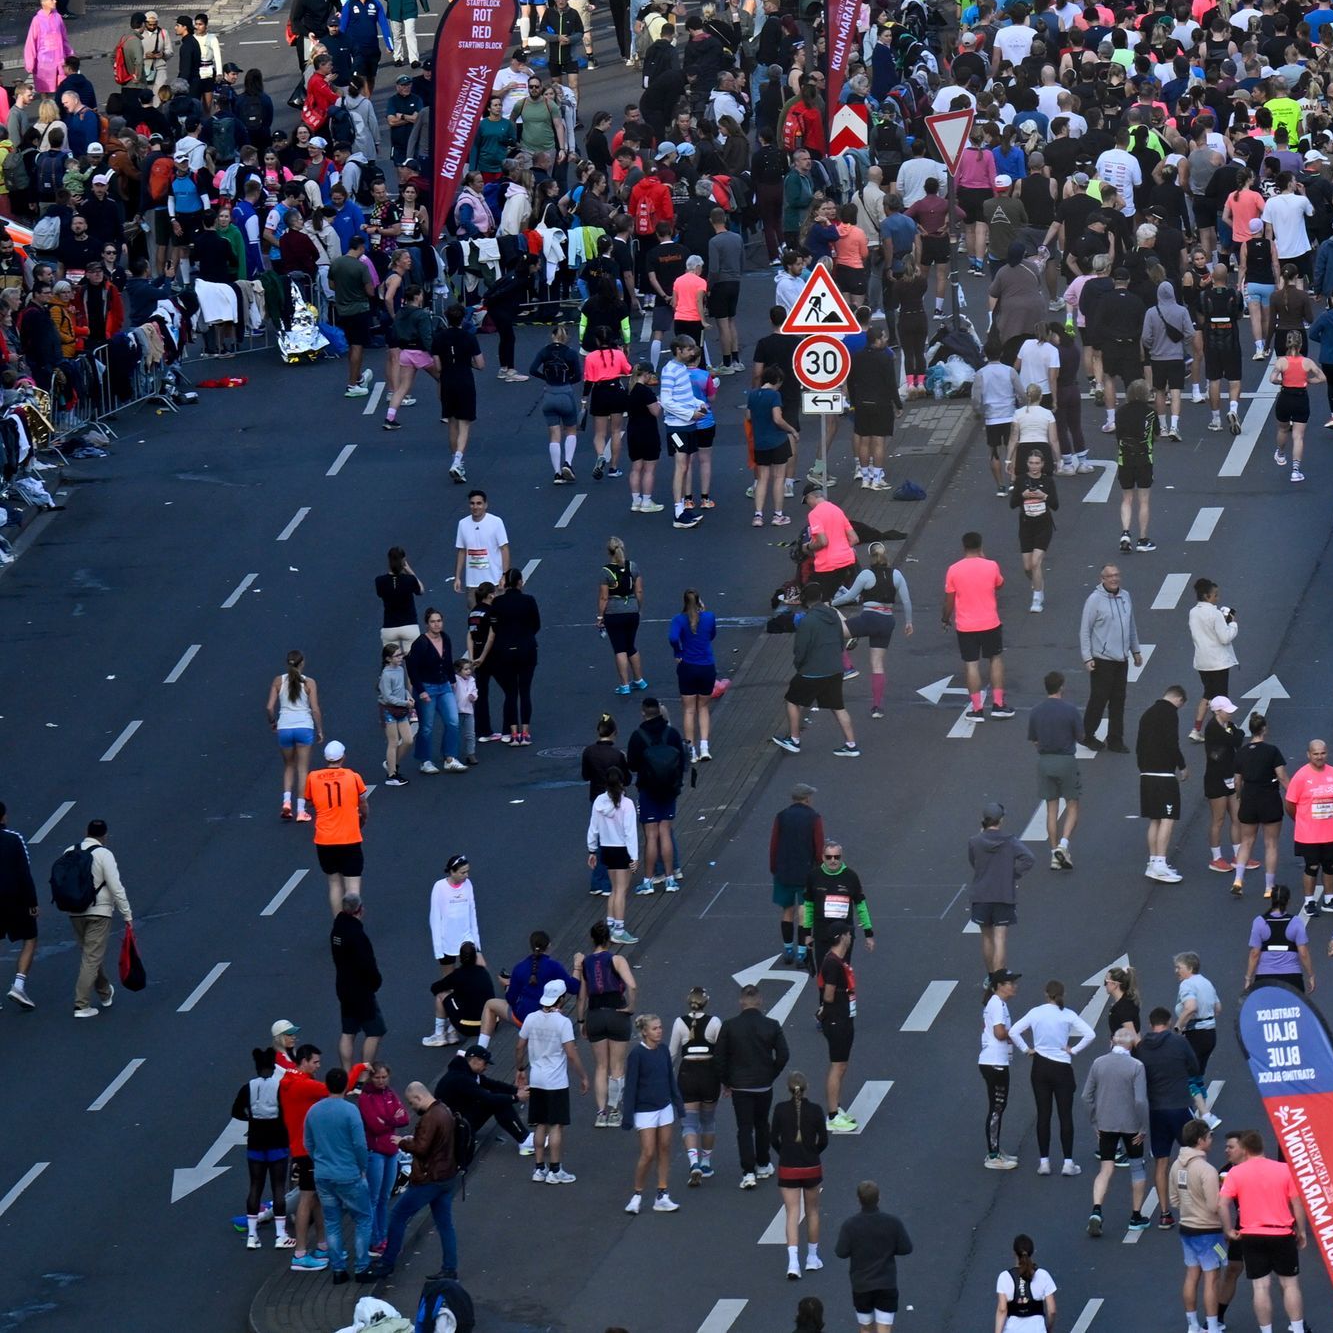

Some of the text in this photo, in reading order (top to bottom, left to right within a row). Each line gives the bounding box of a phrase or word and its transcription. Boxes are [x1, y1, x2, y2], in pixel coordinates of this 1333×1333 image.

[473, 9, 493, 22] ROT
[472, 25, 492, 39] RED
[458, 40, 503, 50] STARTING BLOCK
[441, 82, 485, 180] KÖLN MARATHON
[806, 350, 838, 375] 30
